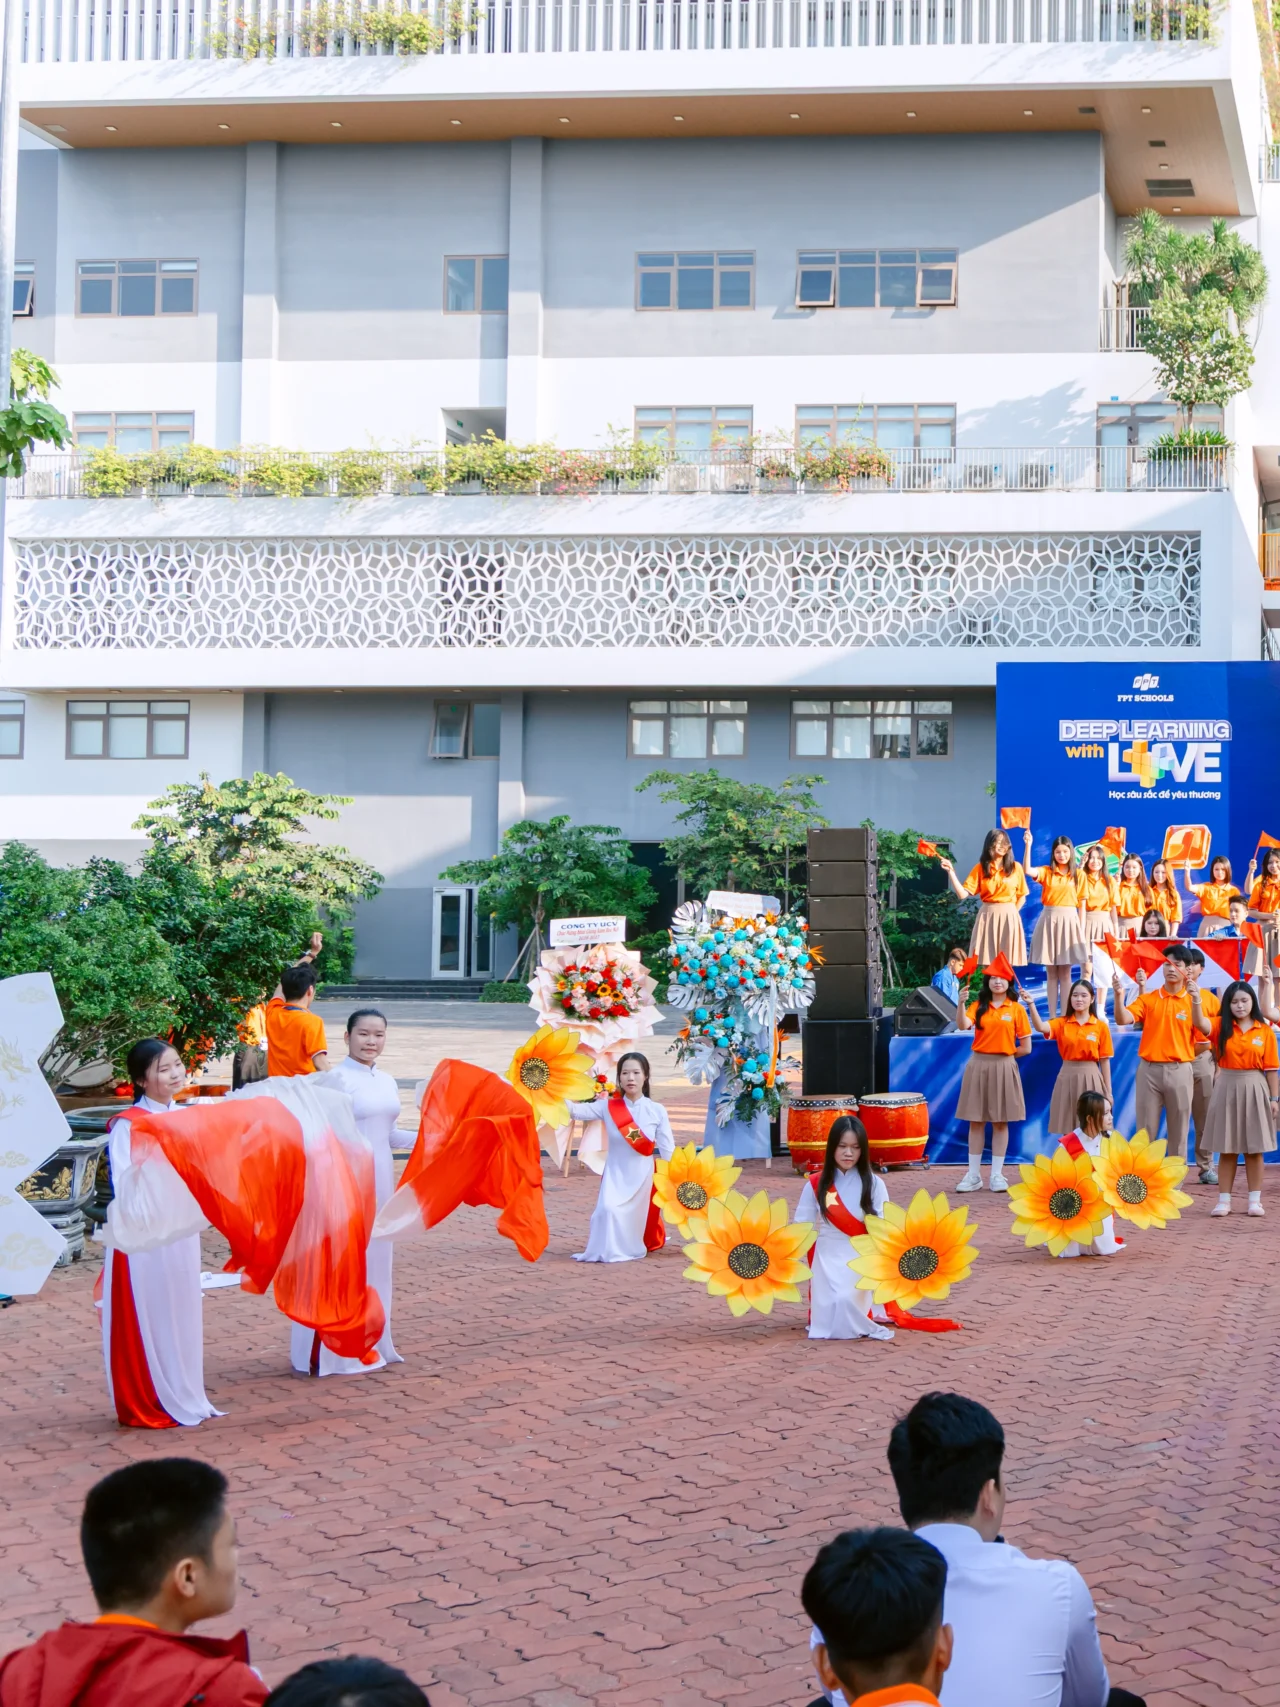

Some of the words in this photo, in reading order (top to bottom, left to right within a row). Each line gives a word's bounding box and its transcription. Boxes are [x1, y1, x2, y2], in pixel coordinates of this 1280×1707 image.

[1117, 694, 1133, 702] FPT
[1134, 694, 1175, 702] SCHOOLS
[1059, 719, 1119, 741] DEEP
[1119, 719, 1232, 741] LEARNING
[1065, 743, 1105, 758] with
[1108, 790, 1126, 800] Học
[1127, 790, 1142, 799] sâu
[1143, 788, 1157, 799] sắc
[1158, 789, 1171, 799] để
[1171, 790, 1188, 800] yêu
[1188, 790, 1221, 800] thương
